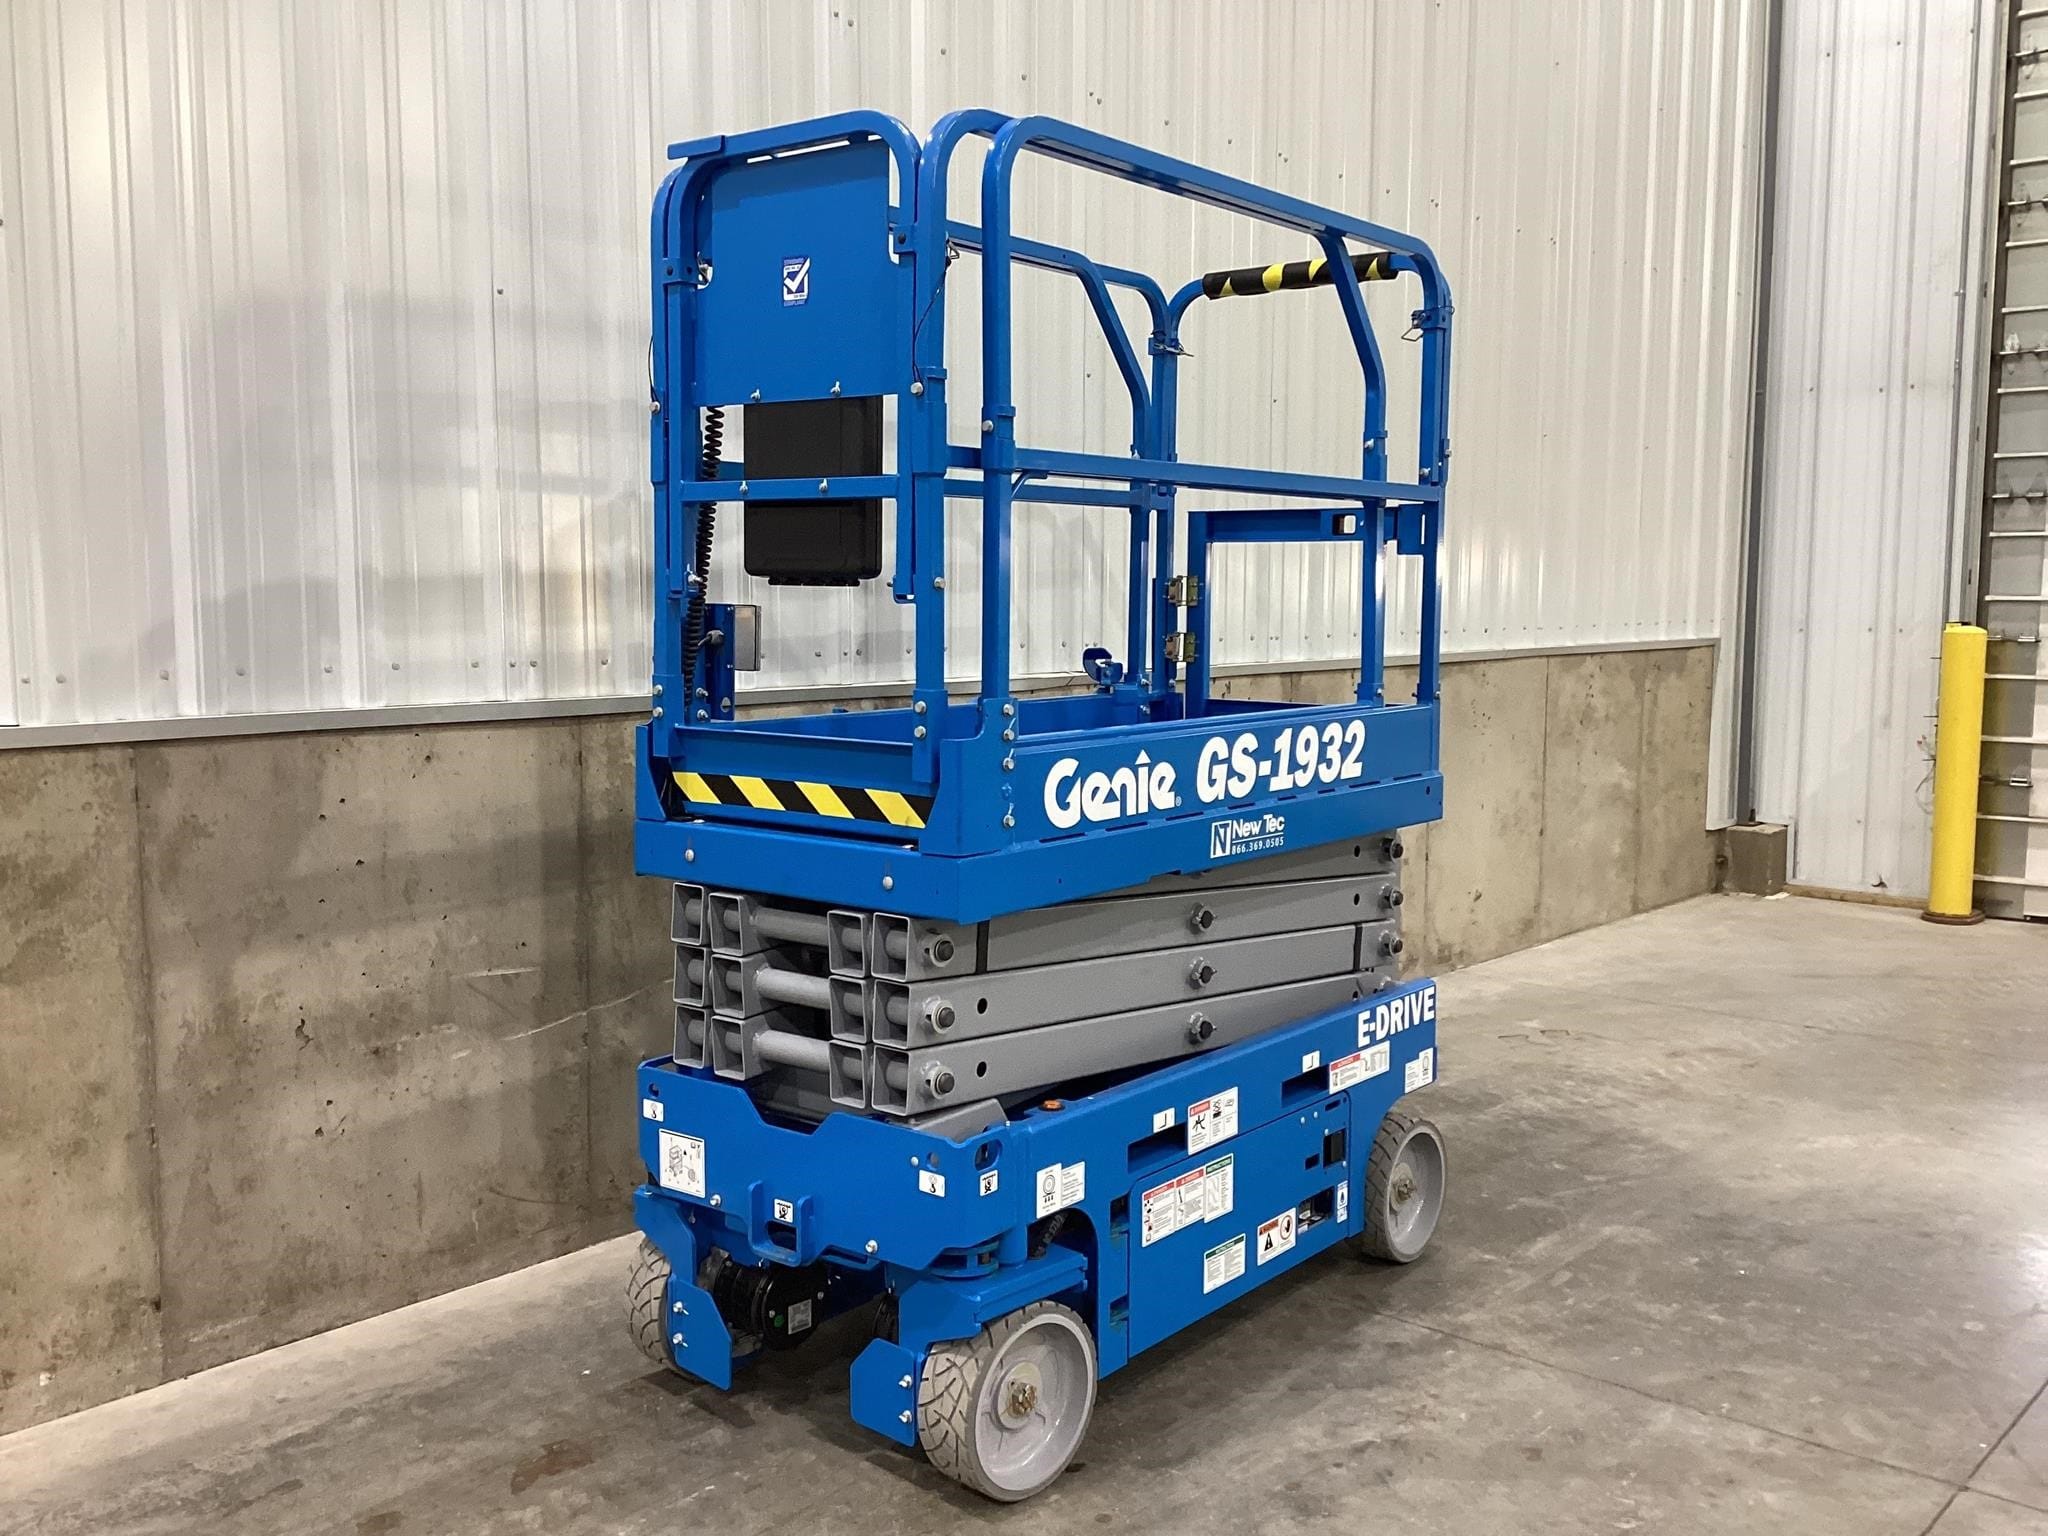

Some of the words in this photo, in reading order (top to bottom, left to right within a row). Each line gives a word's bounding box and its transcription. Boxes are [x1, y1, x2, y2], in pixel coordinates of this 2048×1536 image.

[1044, 749, 1176, 829] Genie
[1196, 719, 1366, 803] GS-1932
[1231, 836, 1284, 855] 866.369.0505
[1232, 818, 1262, 839] New
[1263, 813, 1285, 834] Tec
[1358, 986, 1435, 1048] E-DRIVE
